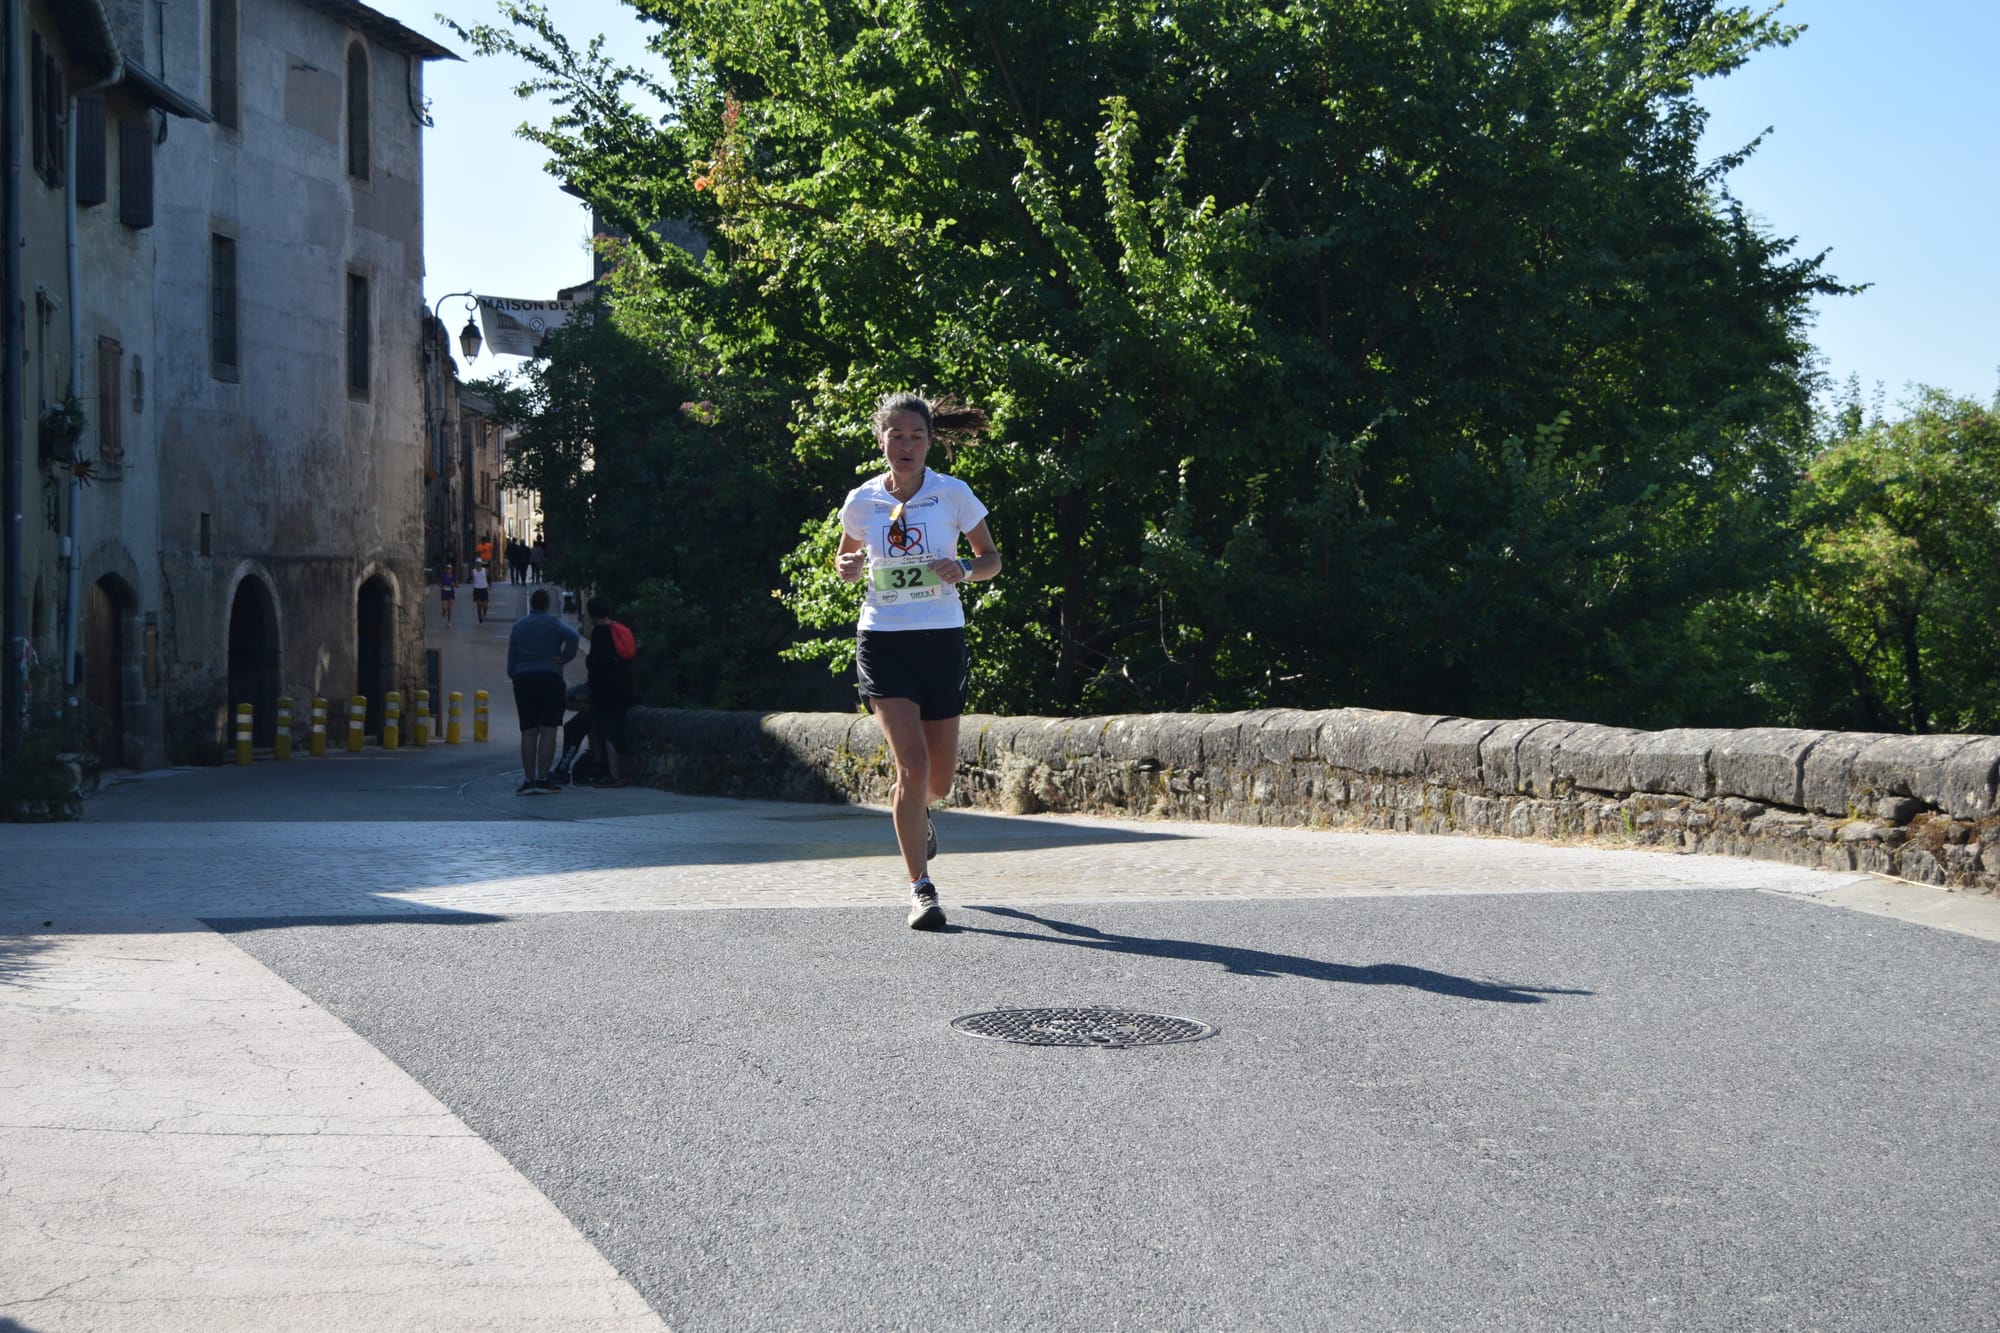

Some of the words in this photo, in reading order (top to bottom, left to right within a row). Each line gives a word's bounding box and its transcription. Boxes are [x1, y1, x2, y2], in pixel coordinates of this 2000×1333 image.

[481, 299, 544, 311] MAISON
[549, 301, 569, 311] DE
[891, 567, 923, 588] 32
